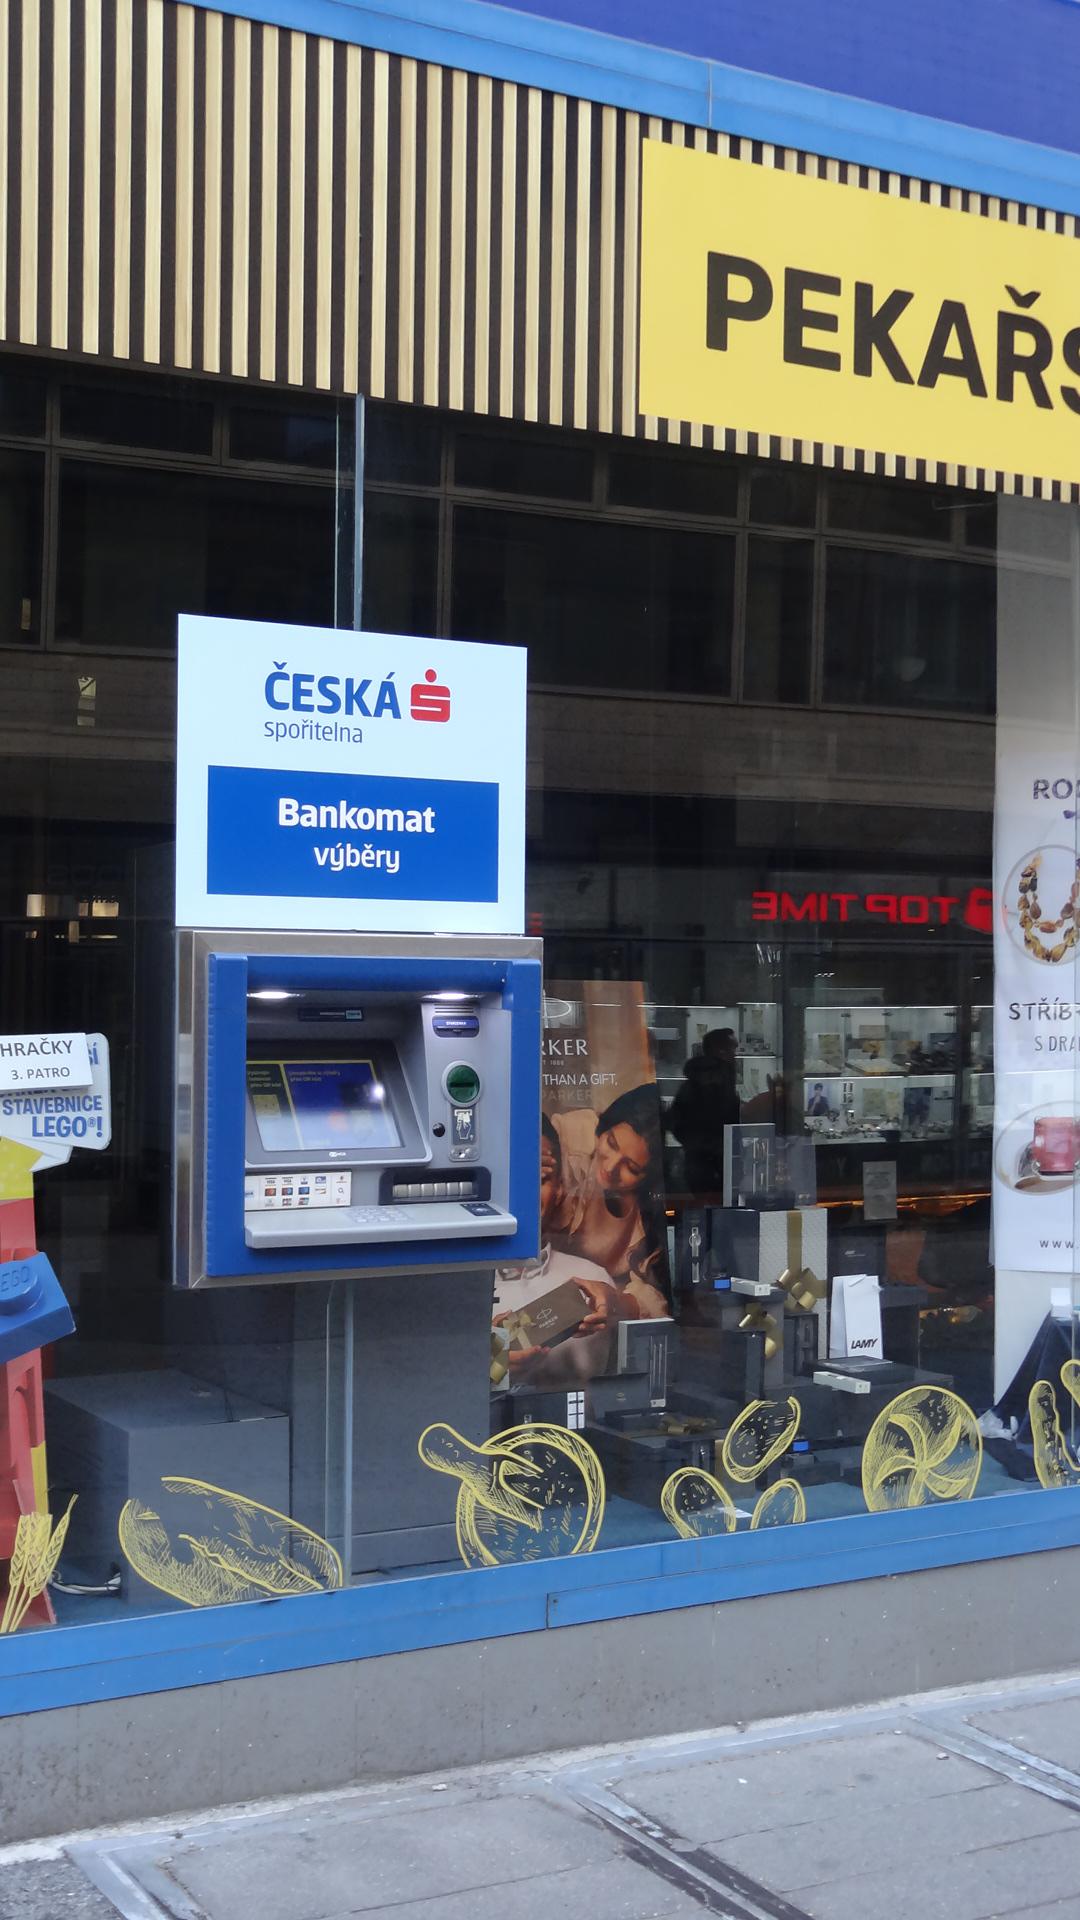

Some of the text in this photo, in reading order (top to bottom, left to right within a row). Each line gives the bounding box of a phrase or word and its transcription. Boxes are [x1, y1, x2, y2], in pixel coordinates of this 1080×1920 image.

[264, 661, 402, 720] ČESKÁ
[264, 719, 363, 743] spořitelna
[1033, 778, 1080, 800] RO
[278, 797, 436, 834] Bankomat
[314, 844, 401, 874] výběry
[0, 1037, 73, 1057] HRAČKY
[1034, 1035, 1043, 1051] S
[11, 1066, 71, 1080] 3. PATRO
[543, 1073, 576, 1086] THAN
[579, 1074, 589, 1086] A
[2, 1094, 103, 1116] STAVEBNICE
[850, 1338, 878, 1350] LAMY
